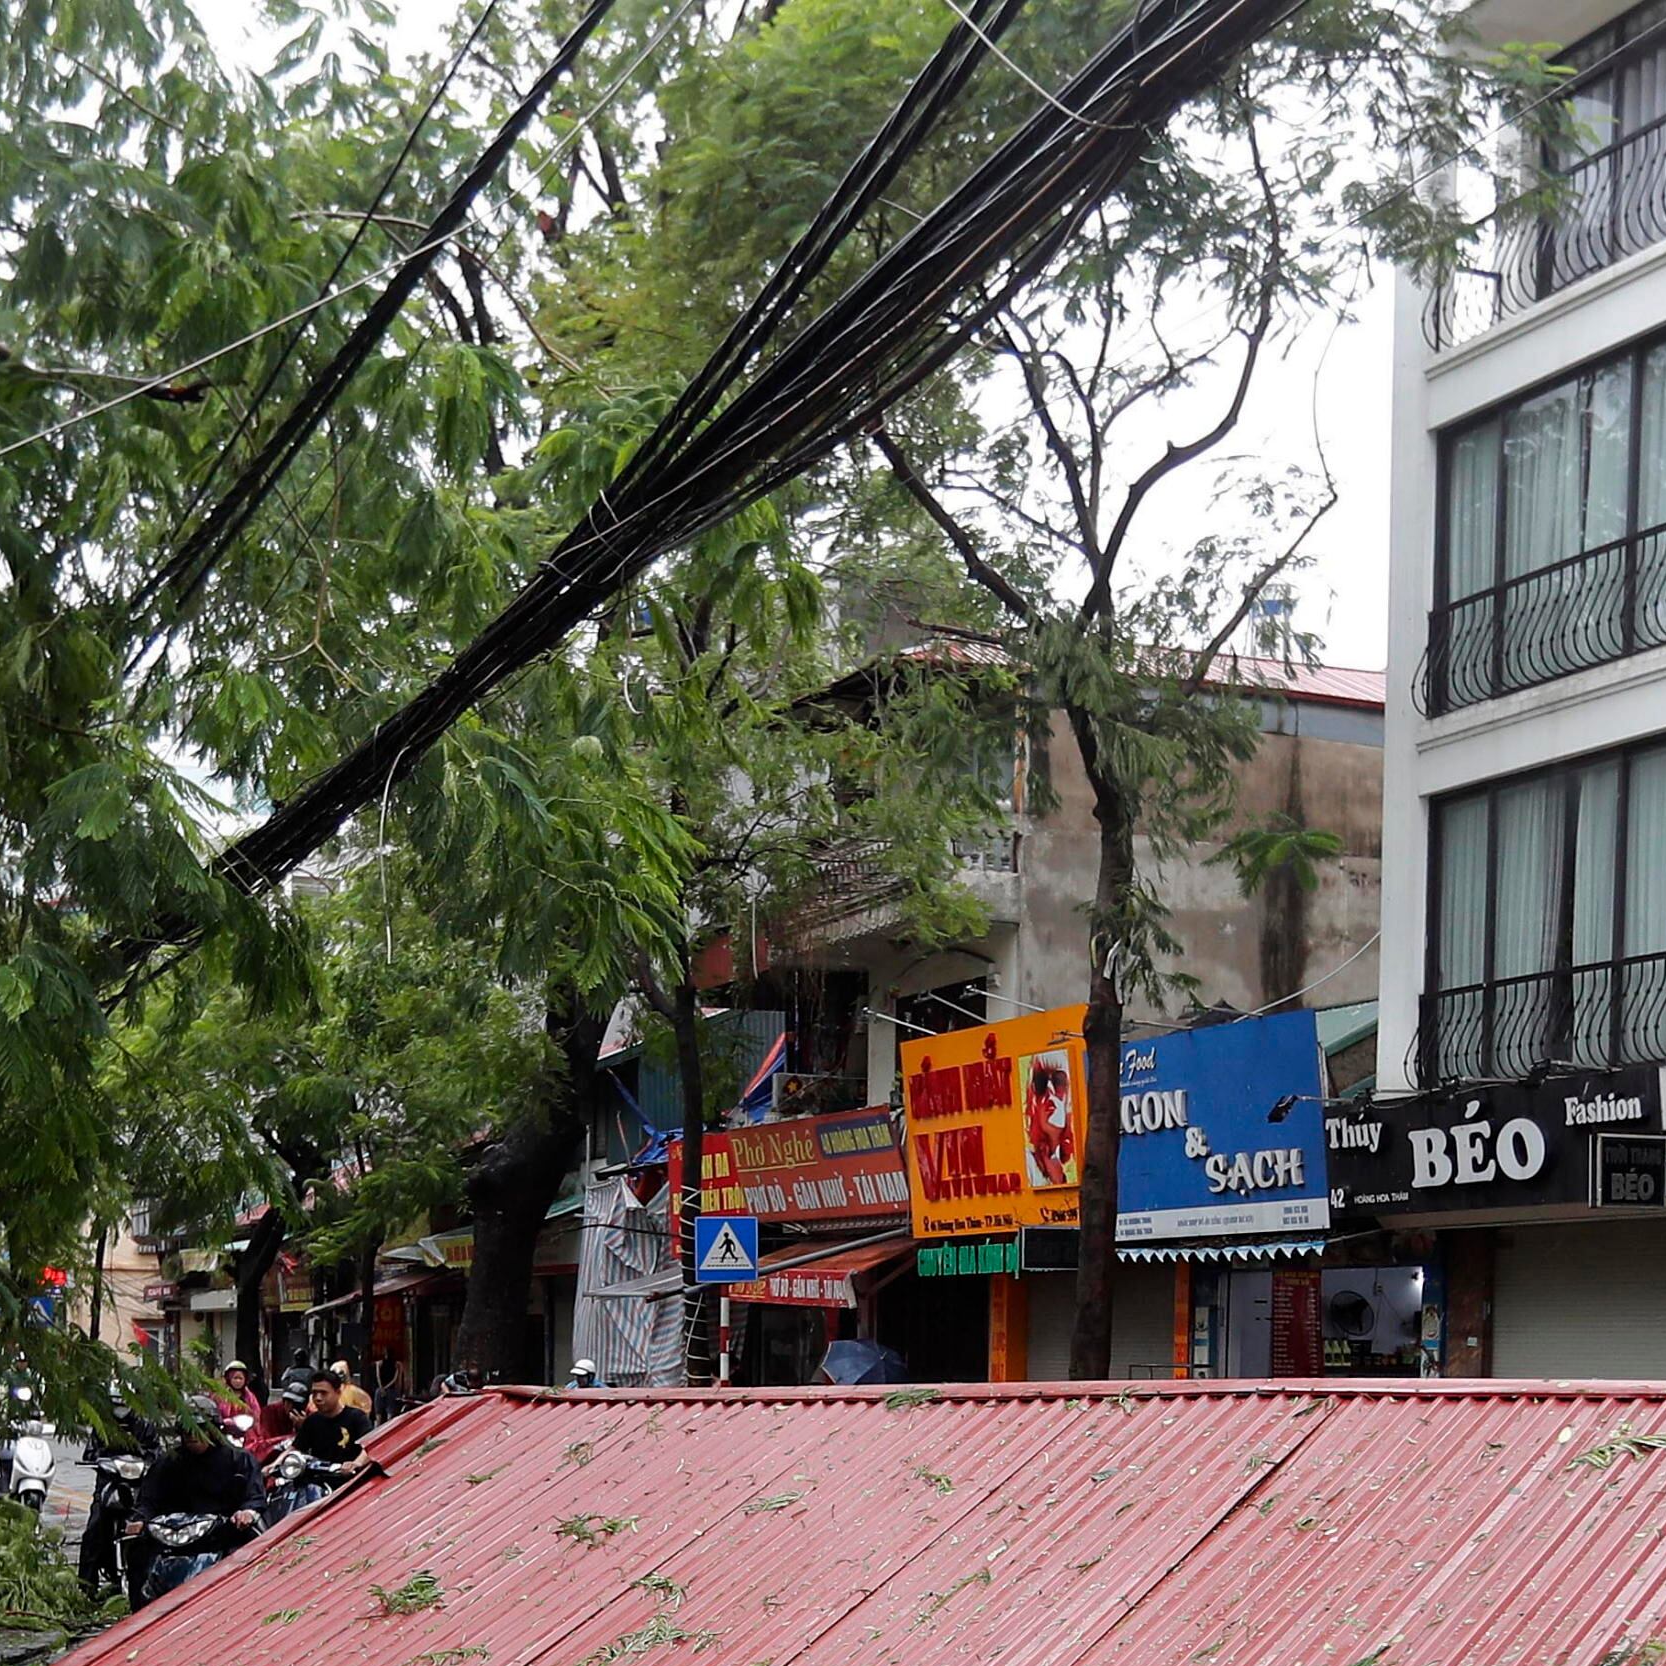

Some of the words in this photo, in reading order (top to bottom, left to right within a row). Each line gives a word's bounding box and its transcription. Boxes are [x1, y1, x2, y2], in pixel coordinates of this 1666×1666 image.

[1125, 1047, 1157, 1080] Food
[1120, 1089, 1187, 1134] GON
[1185, 1127, 1209, 1158] &
[1325, 1113, 1382, 1153] Thúy
[1408, 1100, 1545, 1188] BÉO
[1564, 1093, 1642, 1126] Fashion
[1205, 1148, 1305, 1197] SẠCH
[1611, 1167, 1655, 1200] BÉO
[744, 1174, 769, 1214] PHỞ
[1330, 1188, 1345, 1209] 42
